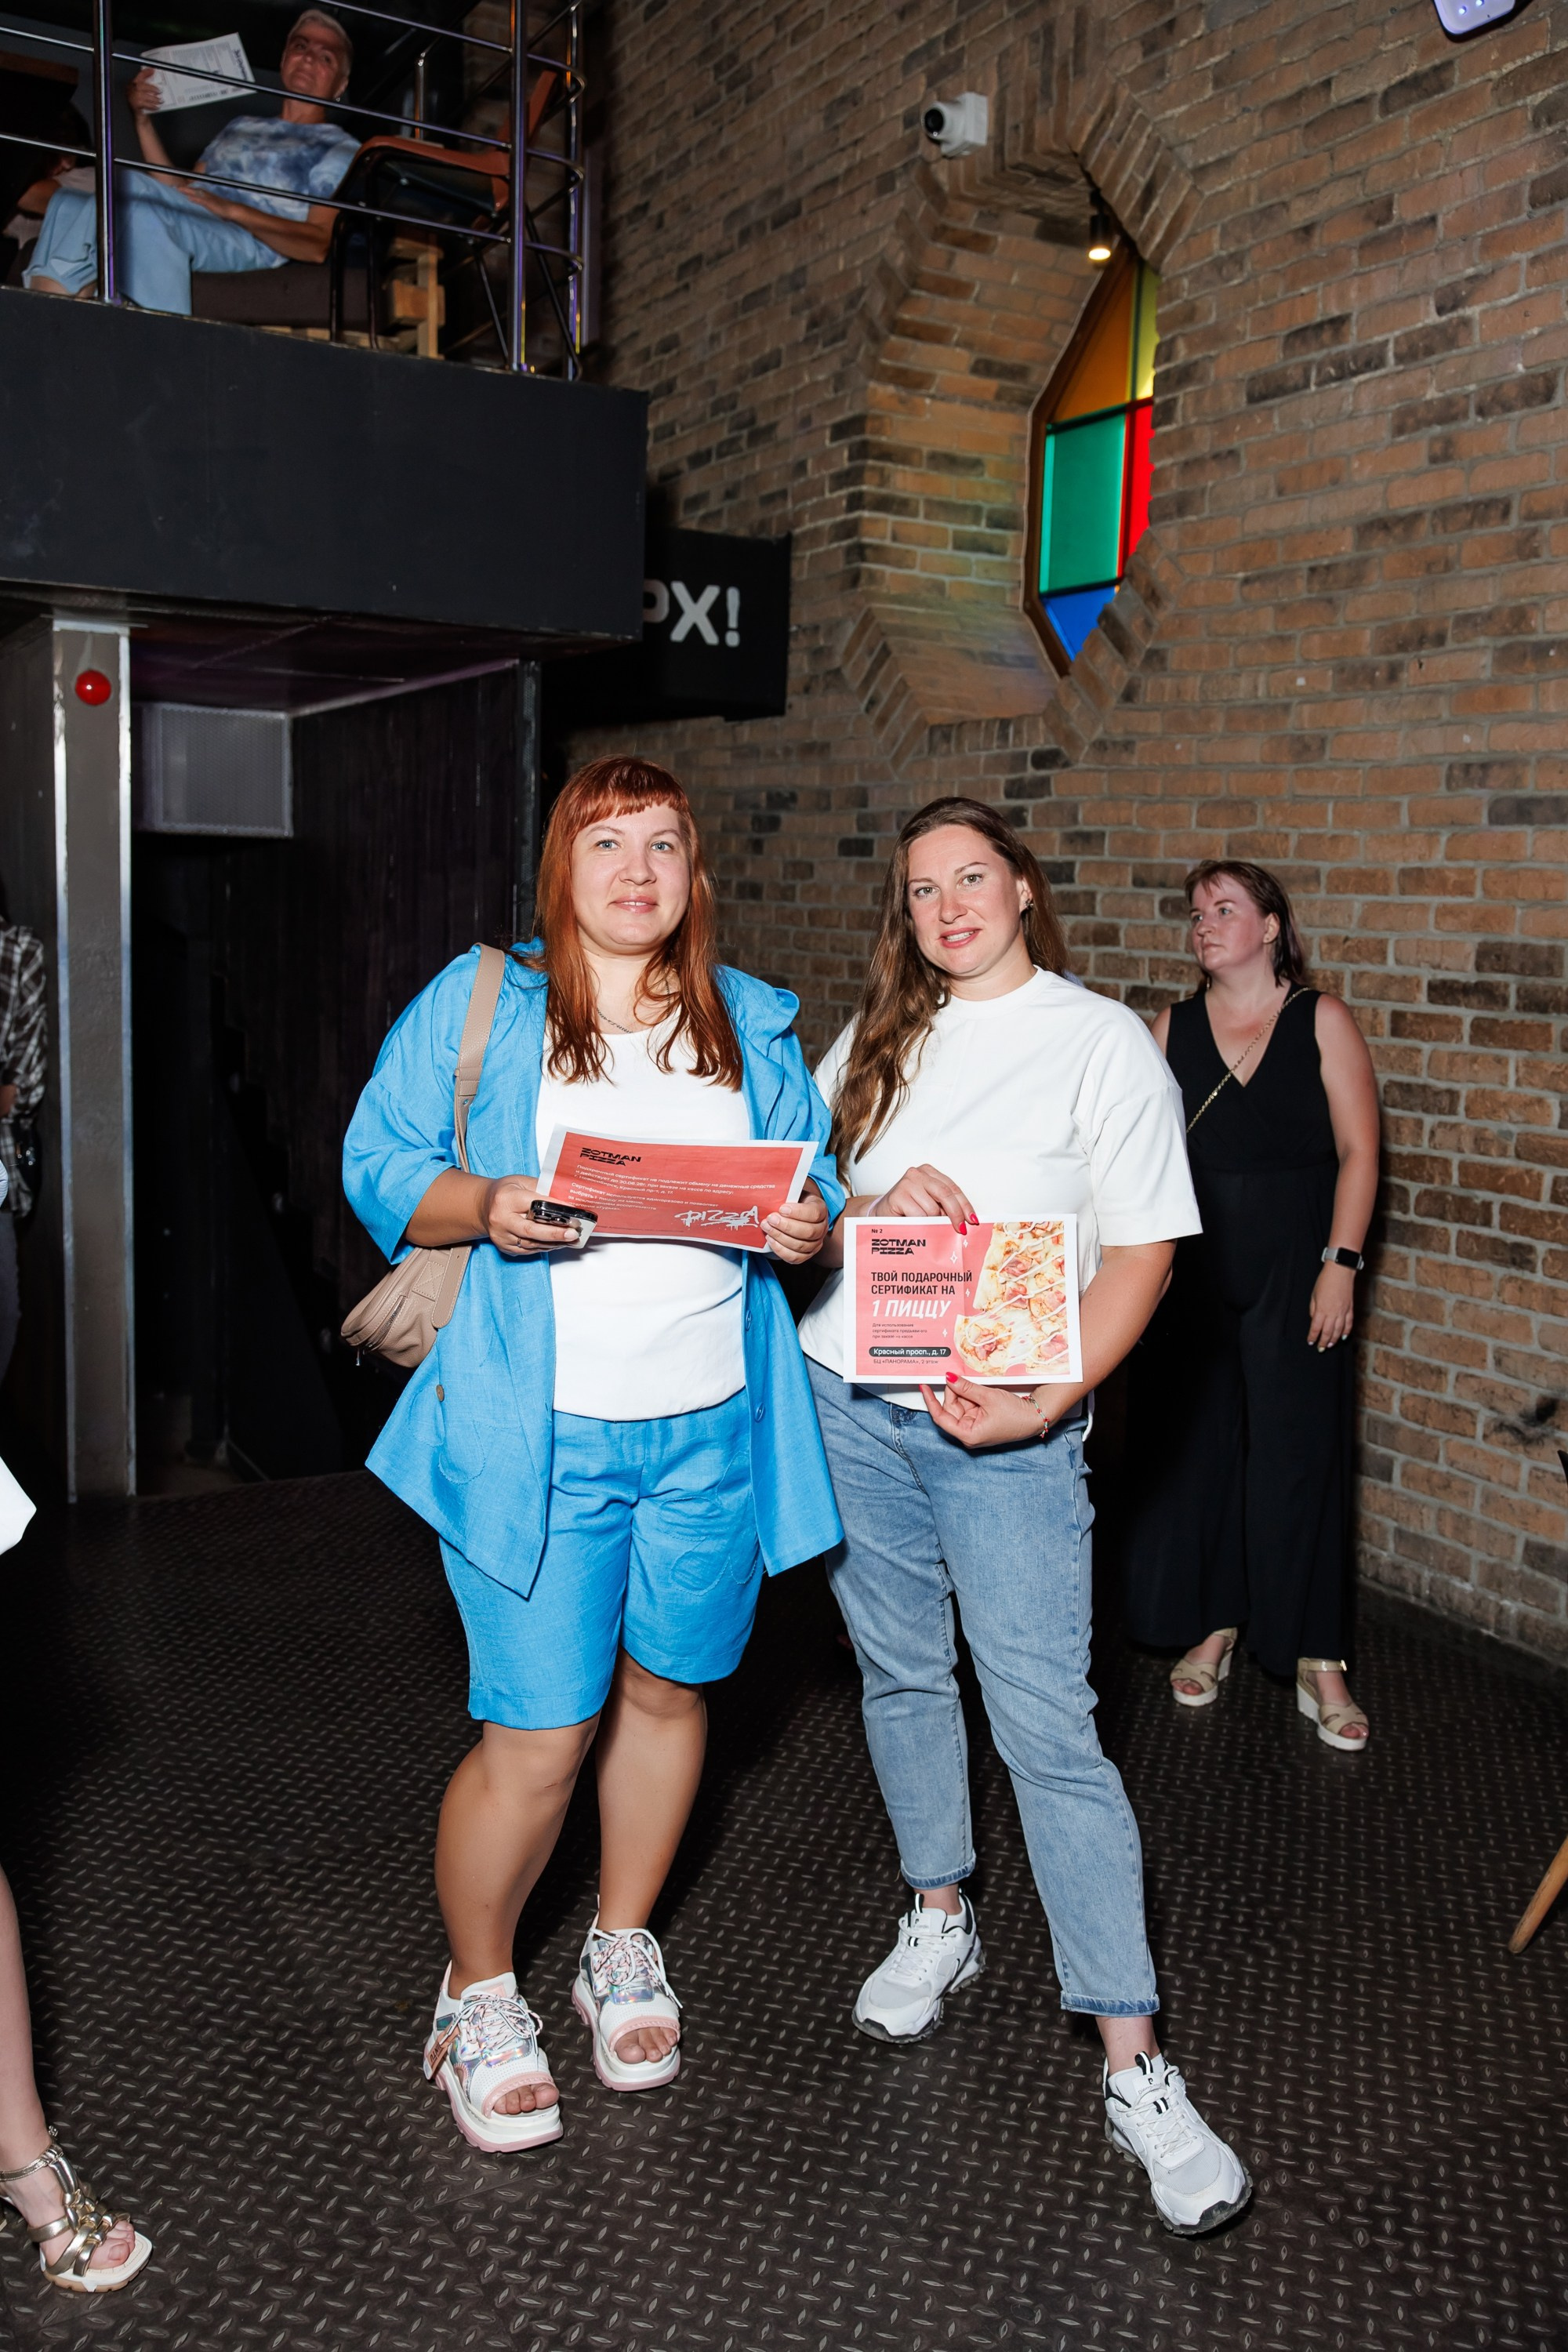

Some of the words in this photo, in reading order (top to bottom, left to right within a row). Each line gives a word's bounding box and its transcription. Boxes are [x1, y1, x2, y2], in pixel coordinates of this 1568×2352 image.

[580, 1153, 626, 1167] PIZZA
[581, 1148, 641, 1163] ZOTMAN
[577, 1164, 615, 1176] Подарочный
[615, 1174, 650, 1182] сертификат
[569, 1189, 593, 1199] выбрать
[572, 1182, 607, 1195] Сертификат
[871, 1270, 898, 1282] ТВОЙ
[902, 1270, 972, 1283] ПОДАРОЧНЫЙ
[871, 1285, 938, 1294] СЕРТИФИКАТ
[942, 1285, 955, 1294] НА
[873, 1299, 880, 1317] 1
[884, 1299, 951, 1319] ПИЦЦУ
